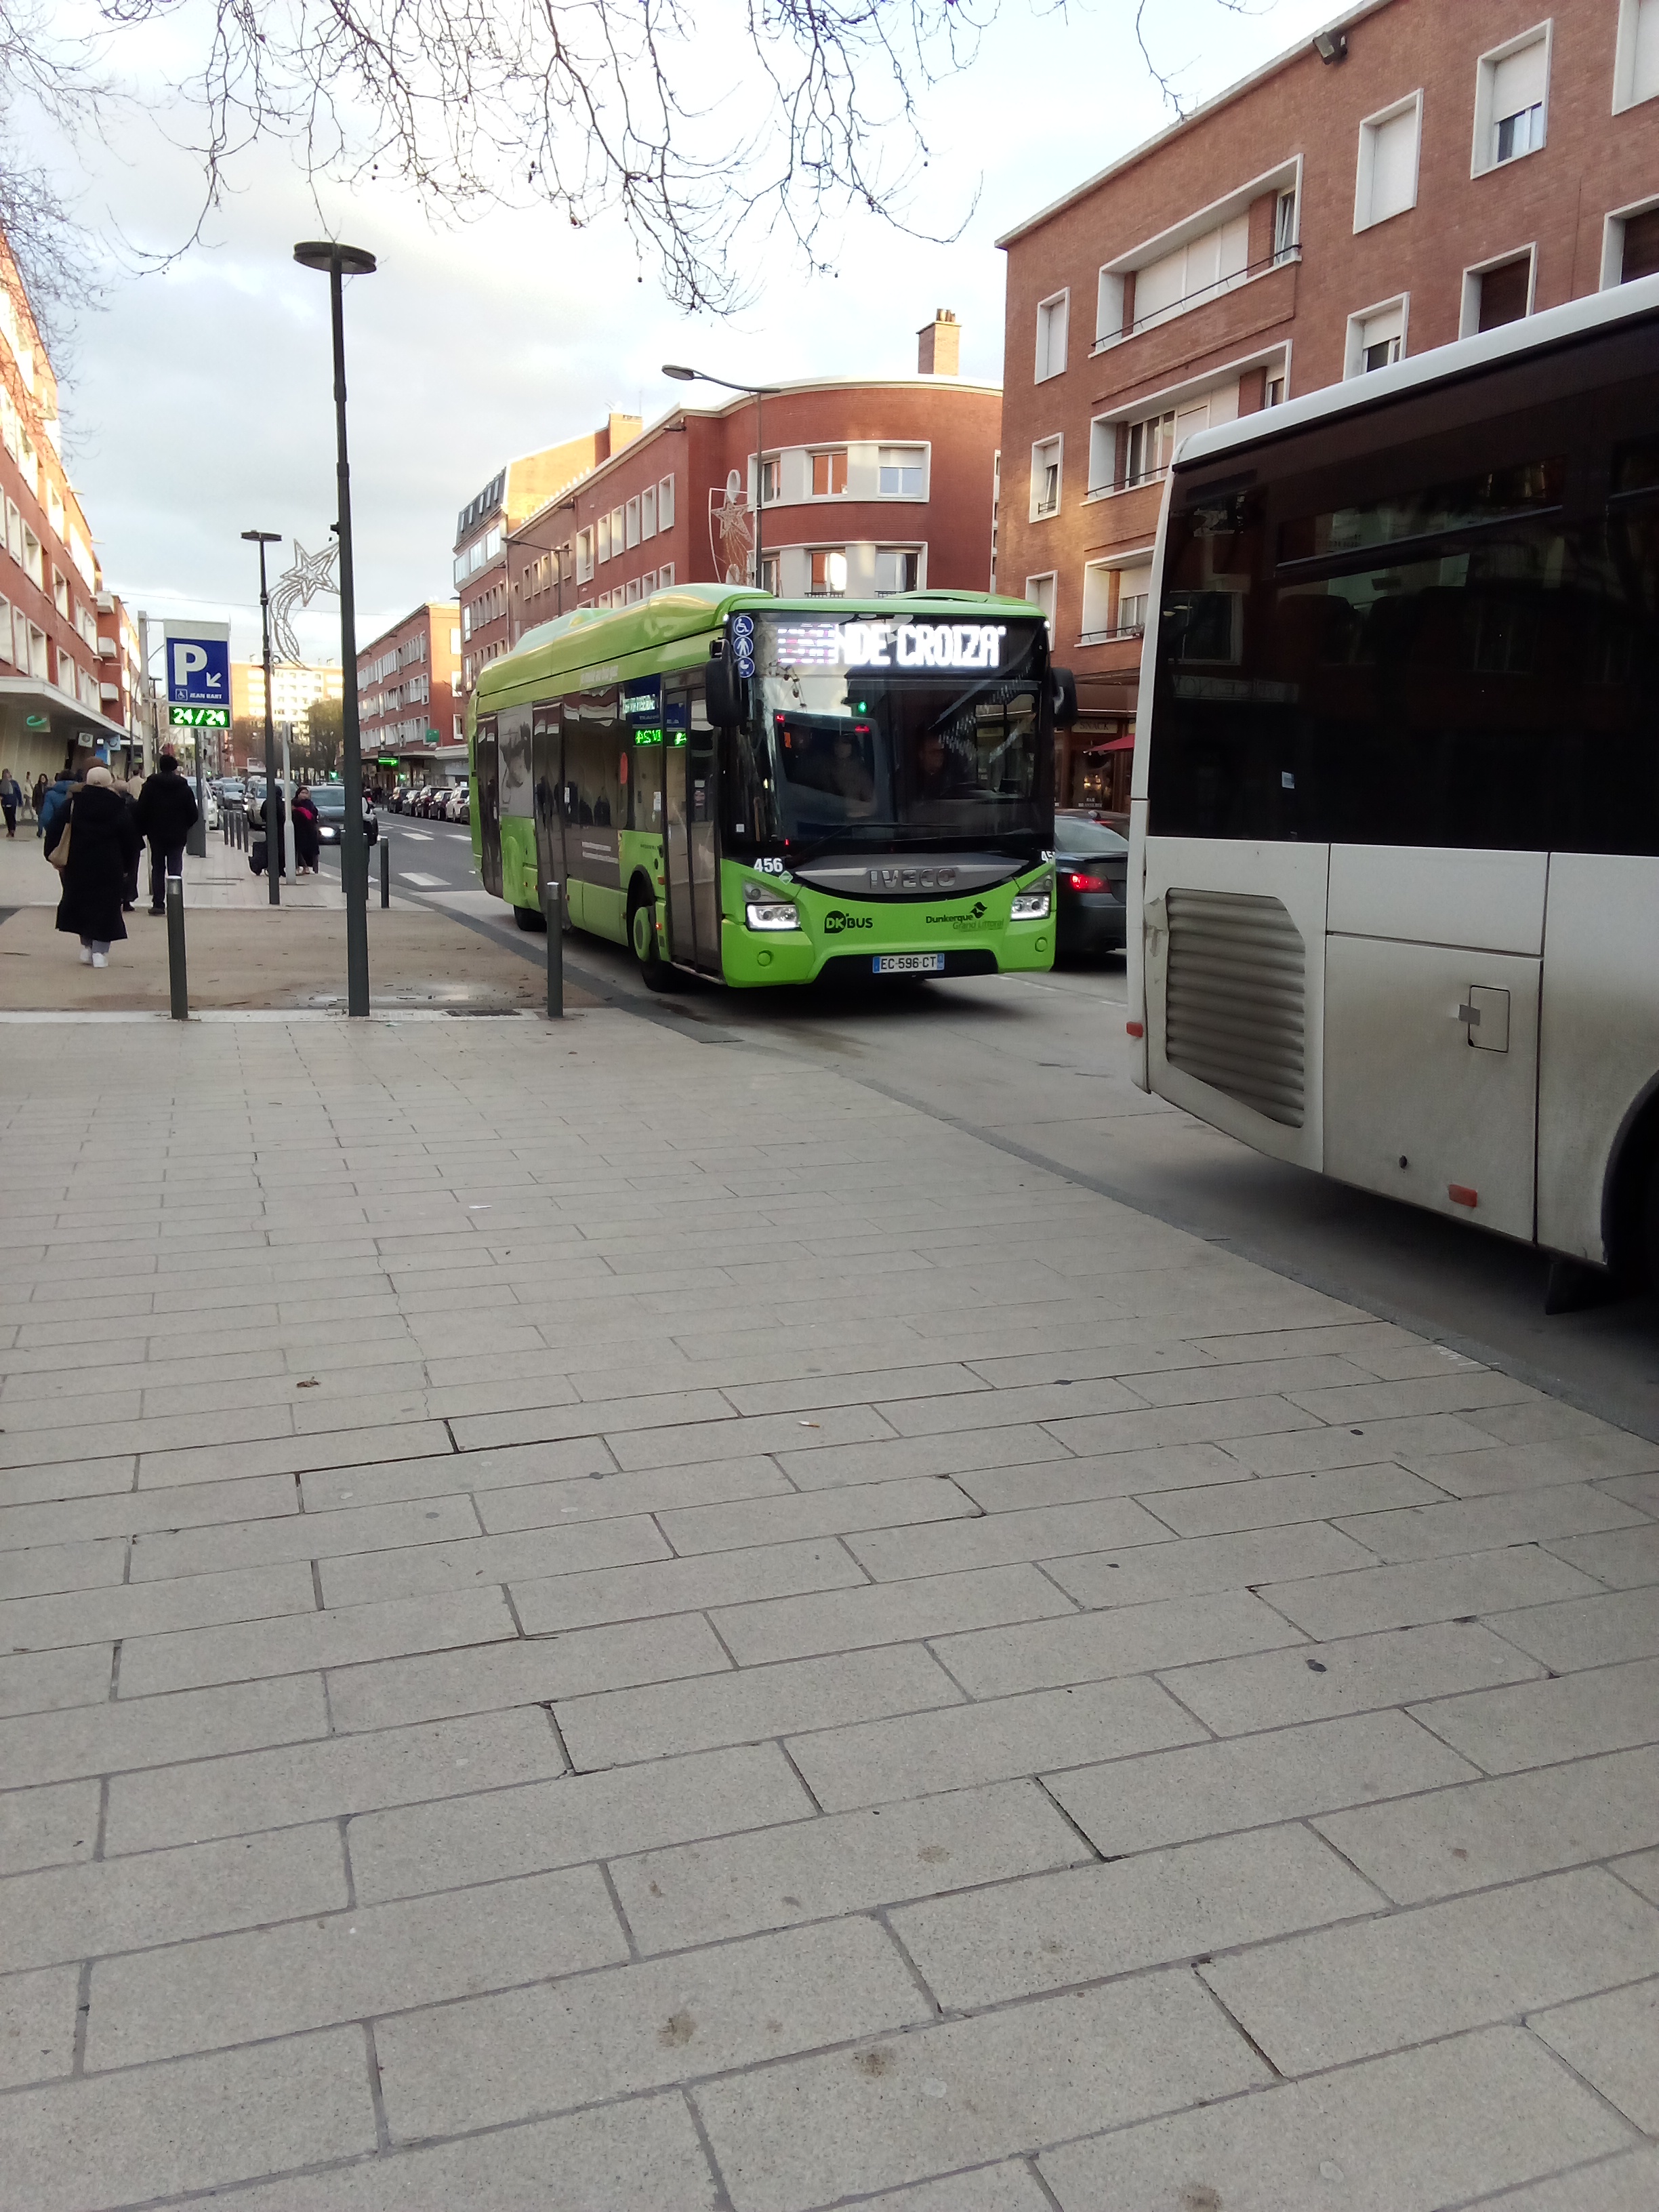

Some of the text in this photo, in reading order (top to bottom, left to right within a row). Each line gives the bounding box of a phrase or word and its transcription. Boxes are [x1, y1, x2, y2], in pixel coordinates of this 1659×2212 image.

[897, 624, 1006, 667] CROIZA
[173, 643, 207, 687] P
[173, 708, 226, 726] 24/24
[1080, 722, 1109, 731] SNACK
[754, 857, 783, 872] 456
[870, 868, 956, 888] IVECO
[926, 914, 973, 924] Dunkerque
[952, 920, 976, 930] Grand
[880, 956, 936, 970] EC-596-CT
